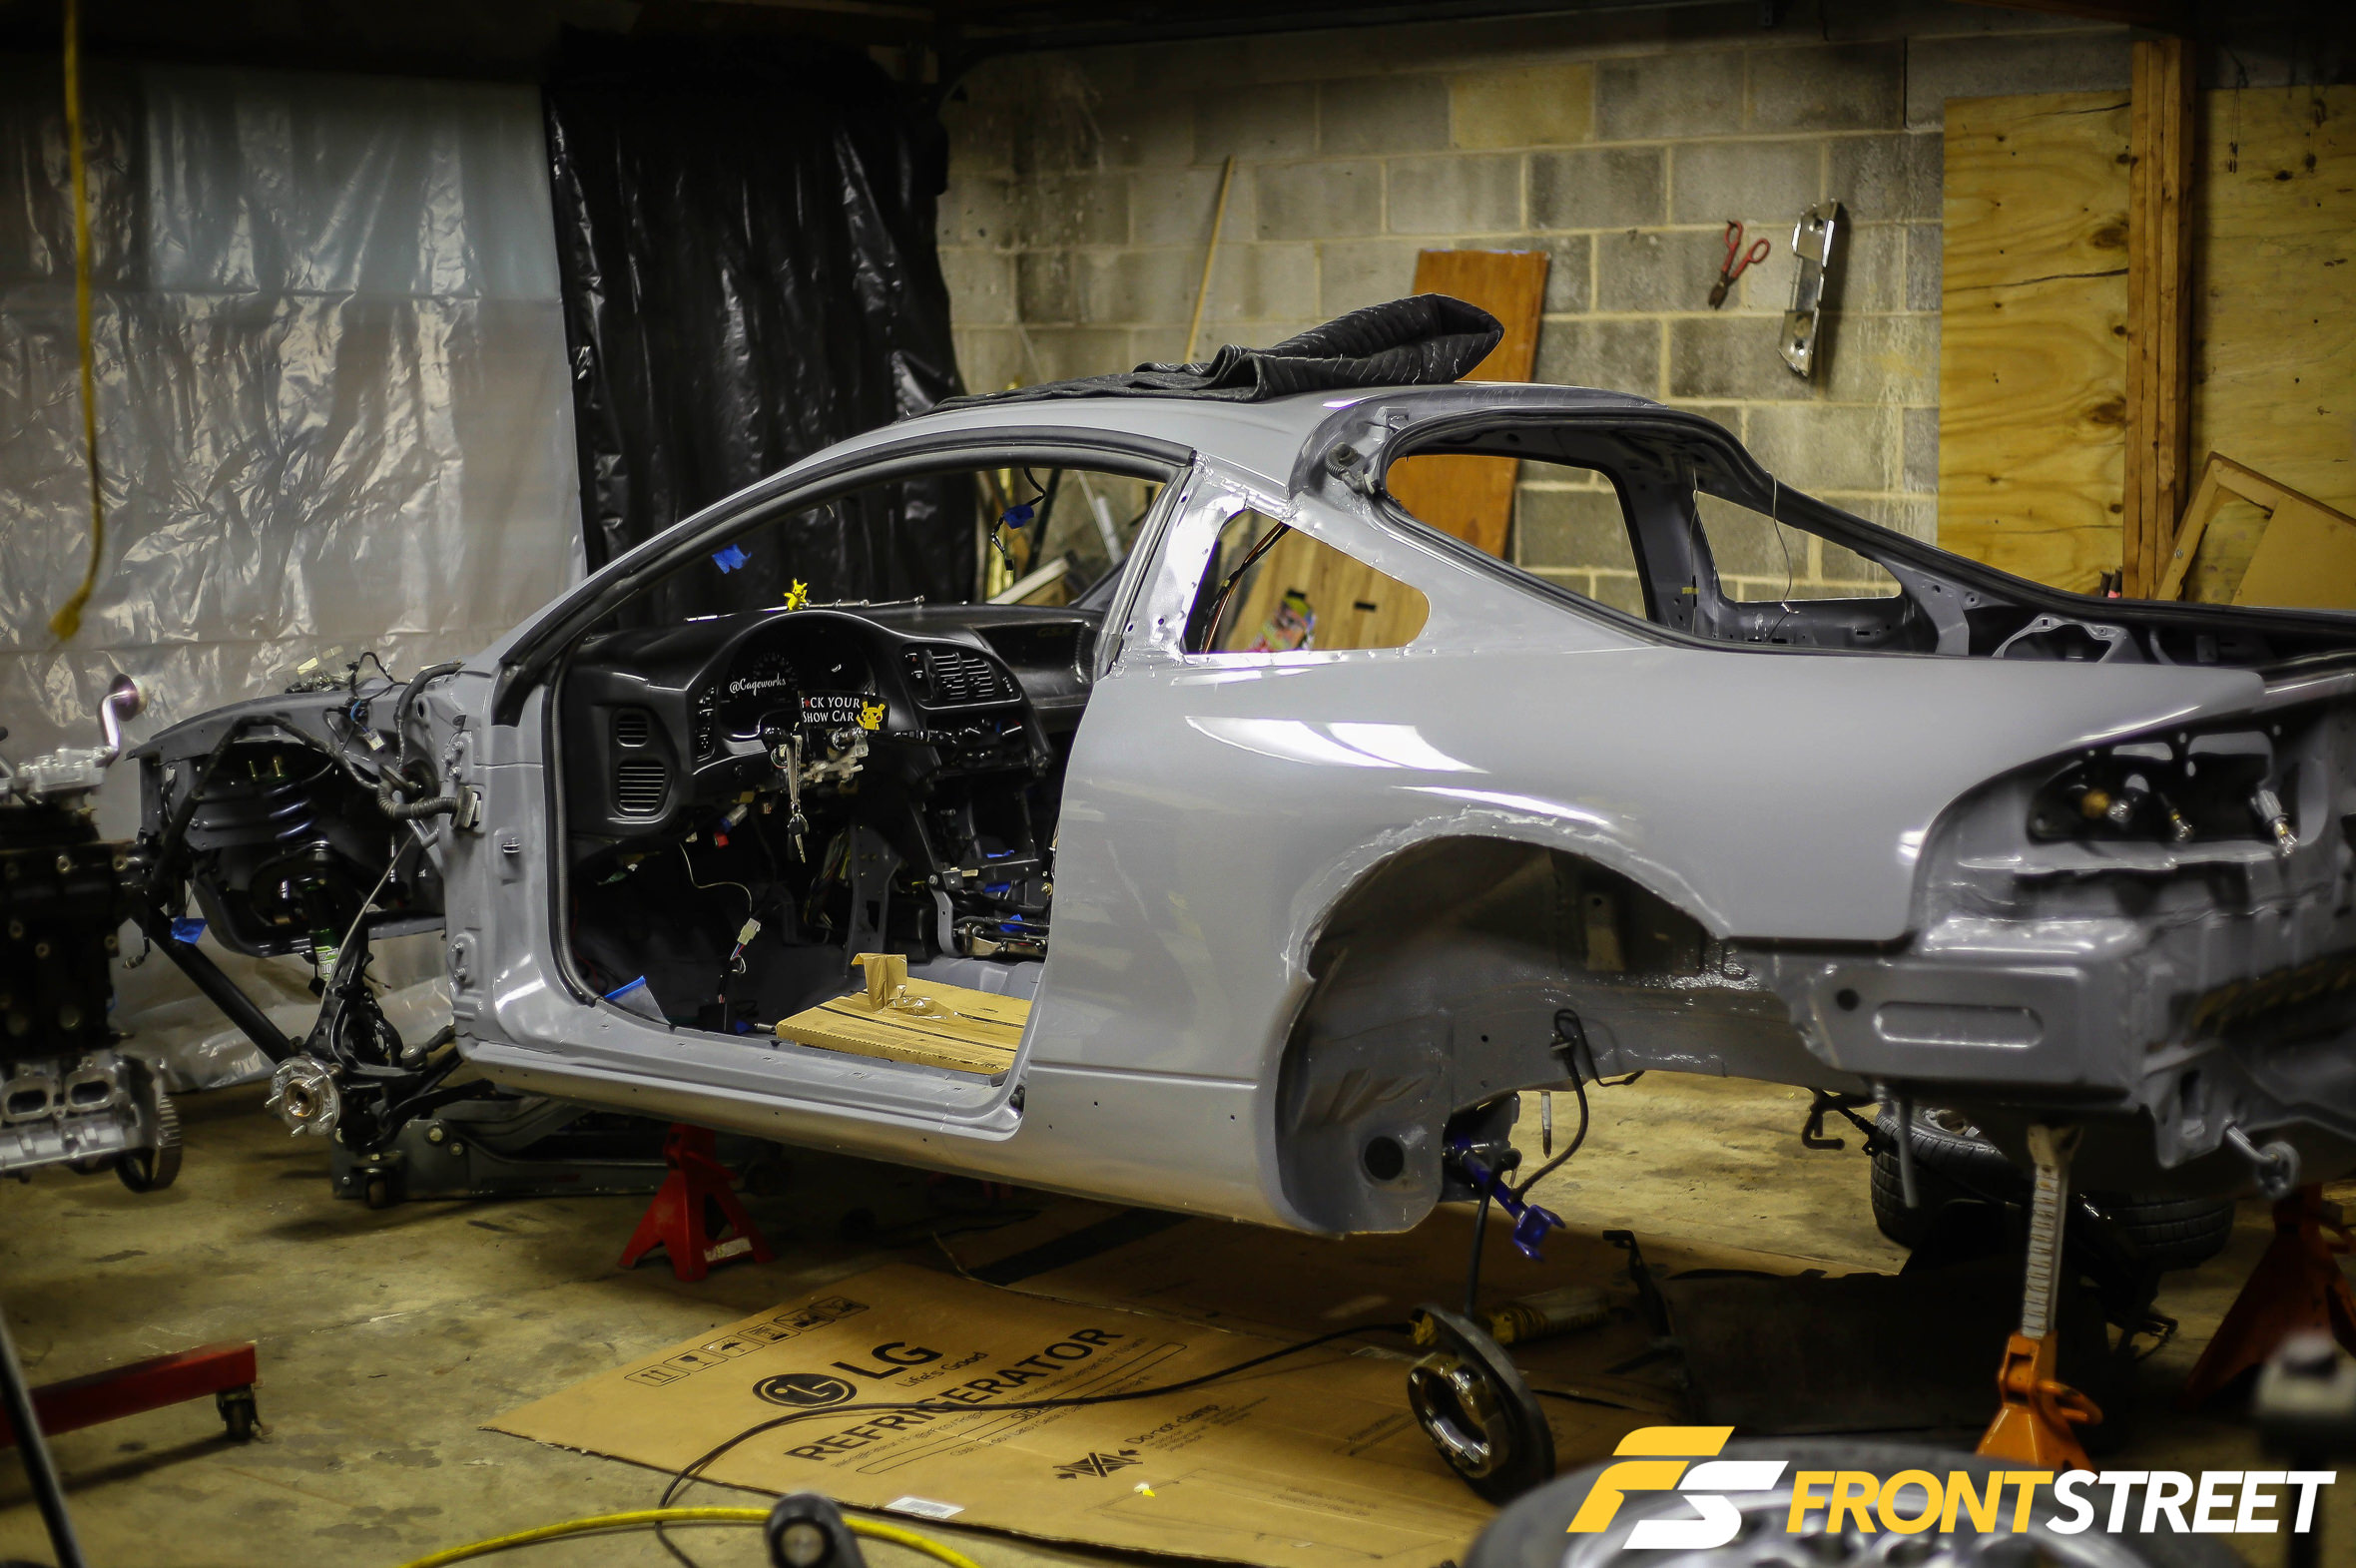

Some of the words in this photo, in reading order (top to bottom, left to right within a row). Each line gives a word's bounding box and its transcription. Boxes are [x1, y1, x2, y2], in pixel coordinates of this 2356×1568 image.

[729, 672, 787, 697] @Cageworks
[828, 697, 861, 709] YOUR
[803, 711, 829, 723] SHOW
[832, 710, 855, 723] CAR
[830, 1341, 943, 1380] LG
[894, 1369, 944, 1387] Life's
[940, 1351, 989, 1371] Good
